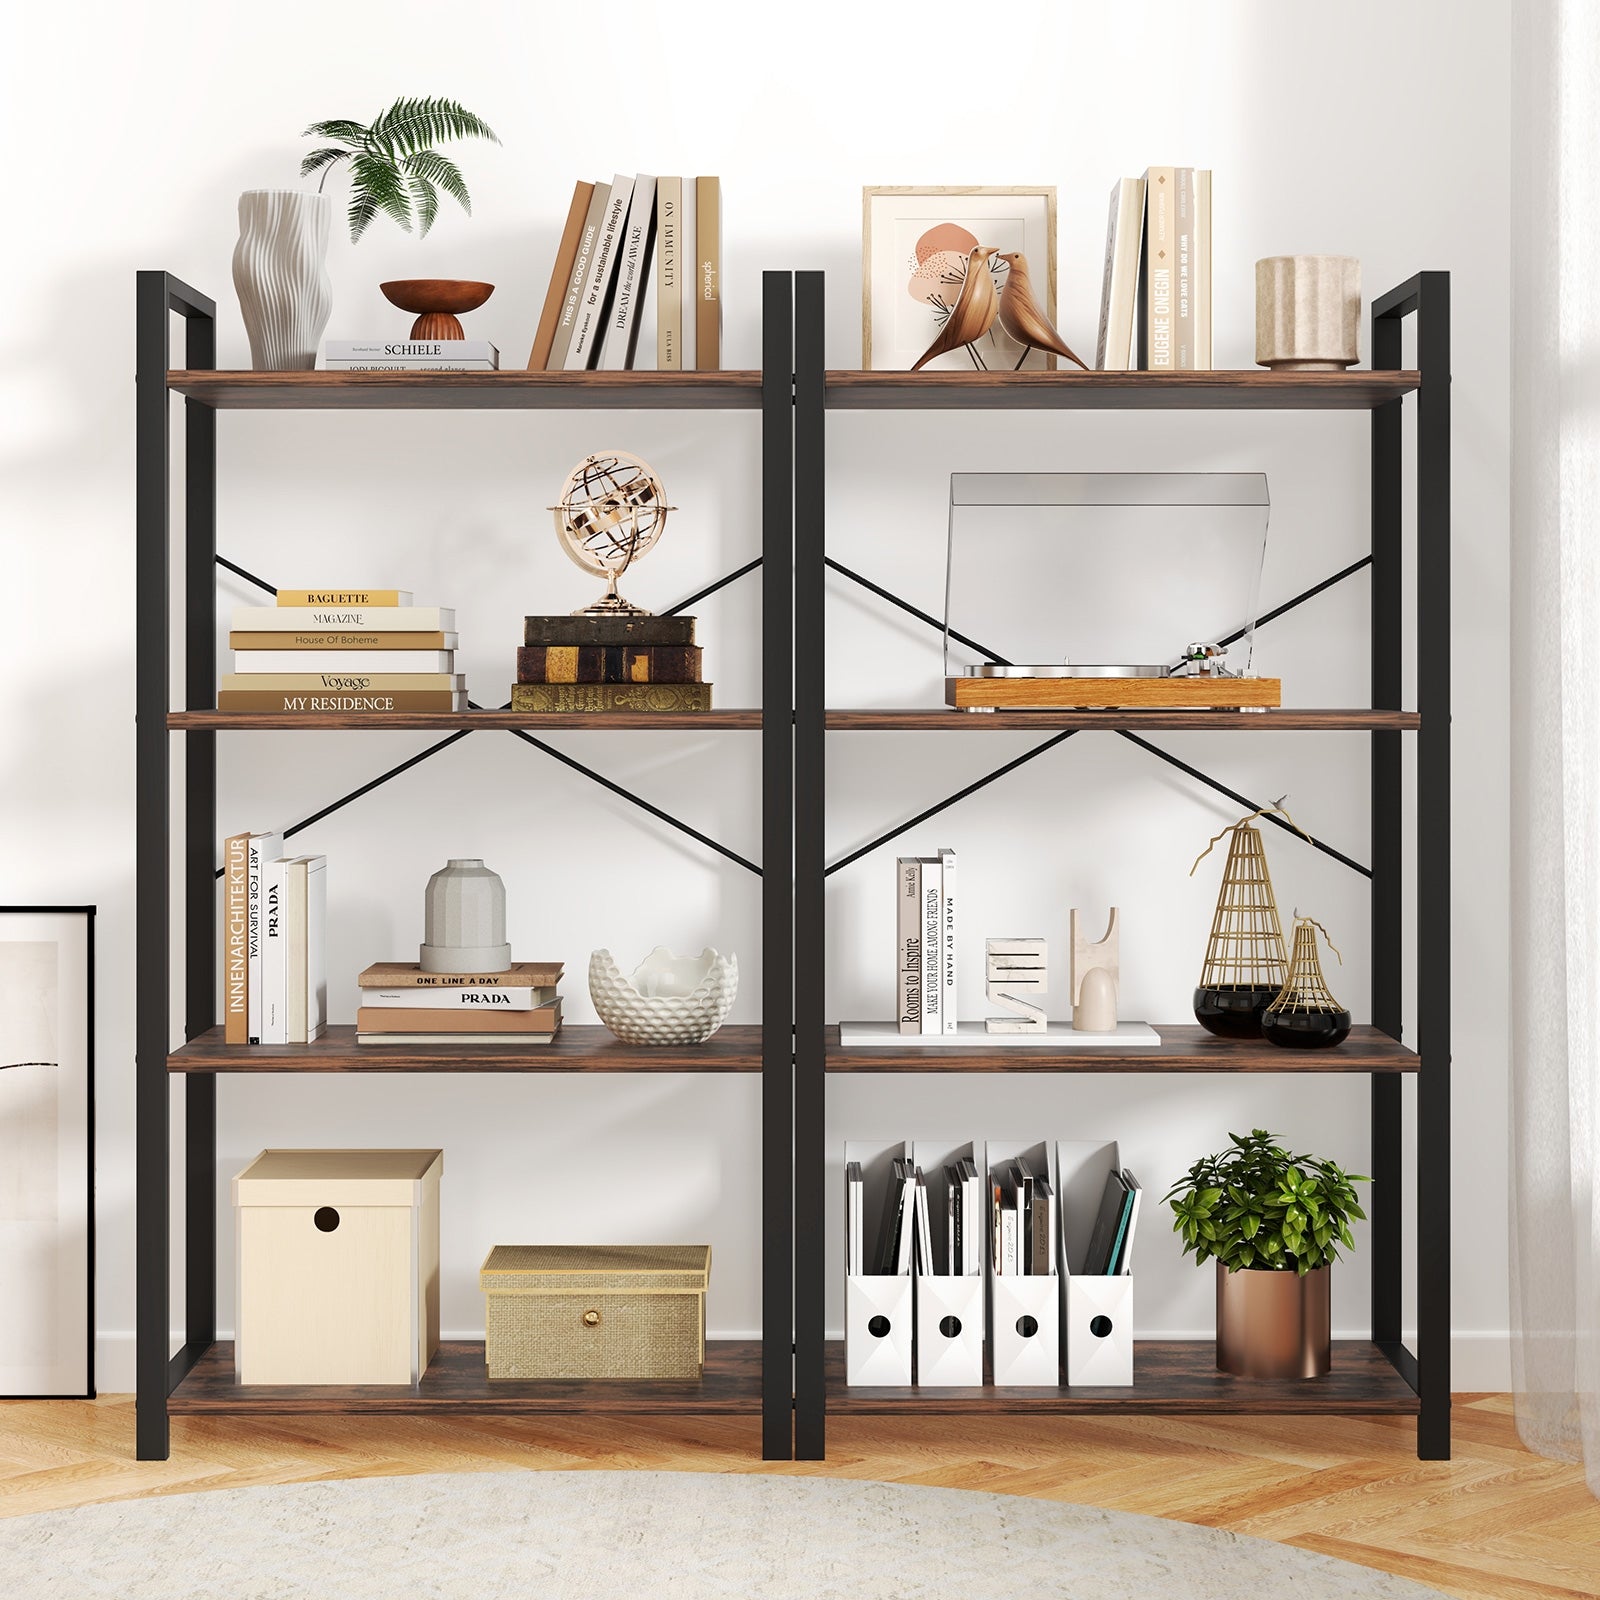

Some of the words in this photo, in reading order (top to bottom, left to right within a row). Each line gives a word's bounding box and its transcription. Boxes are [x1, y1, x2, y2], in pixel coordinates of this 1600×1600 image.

[664, 201, 674, 217] ON
[587, 293, 597, 305] for
[595, 234, 613, 283] sustainable
[607, 199, 623, 233] lifestyle
[629, 226, 642, 261] AWAKE
[1180, 234, 1188, 252] WHY
[664, 224, 674, 288] IMMUNITY
[1180, 253, 1188, 264] DO
[562, 305, 574, 327] THIS
[568, 295, 577, 305] IS
[574, 256, 587, 284] GOOD
[582, 225, 595, 255] GUIDE
[627, 261, 635, 282] world
[701, 261, 717, 301] spherical
[1180, 265, 1188, 278] WE
[623, 282, 632, 292] the
[1154, 269, 1169, 314] ONEGIN
[1180, 279, 1188, 297] LOVE
[616, 292, 631, 329] DREAM
[1180, 299, 1188, 318] CATS
[384, 344, 442, 356] SCHIELE
[1154, 318, 1169, 365] EUGENE
[308, 594, 369, 604] BAGUETTE
[313, 614, 365, 625] MAGAZINE
[295, 636, 324, 644] House
[326, 635, 339, 644] Of
[341, 636, 378, 644] Boheme
[321, 675, 371, 691] Voyage
[283, 697, 308, 710] MY
[310, 697, 394, 711] RESIDENCE
[250, 847, 259, 870] ART
[250, 875, 259, 899] FOR
[269, 884, 278, 937] PRADA
[926, 888, 938, 919] FRIENDS
[946, 898, 954, 930] MADE
[230, 840, 244, 1013] INNENARCHITEKTUR
[250, 904, 259, 959] SURVIVAL
[926, 920, 938, 948] AMONG
[946, 935, 954, 949] BY
[901, 938, 921, 972] Inspire
[926, 948, 938, 971] HOME
[905, 975, 919, 986] to
[946, 954, 954, 986] HAND
[926, 972, 938, 993] YOUR
[461, 993, 511, 1004] PRADA
[902, 988, 919, 1023] Rooms
[926, 993, 938, 1014] MAKE
